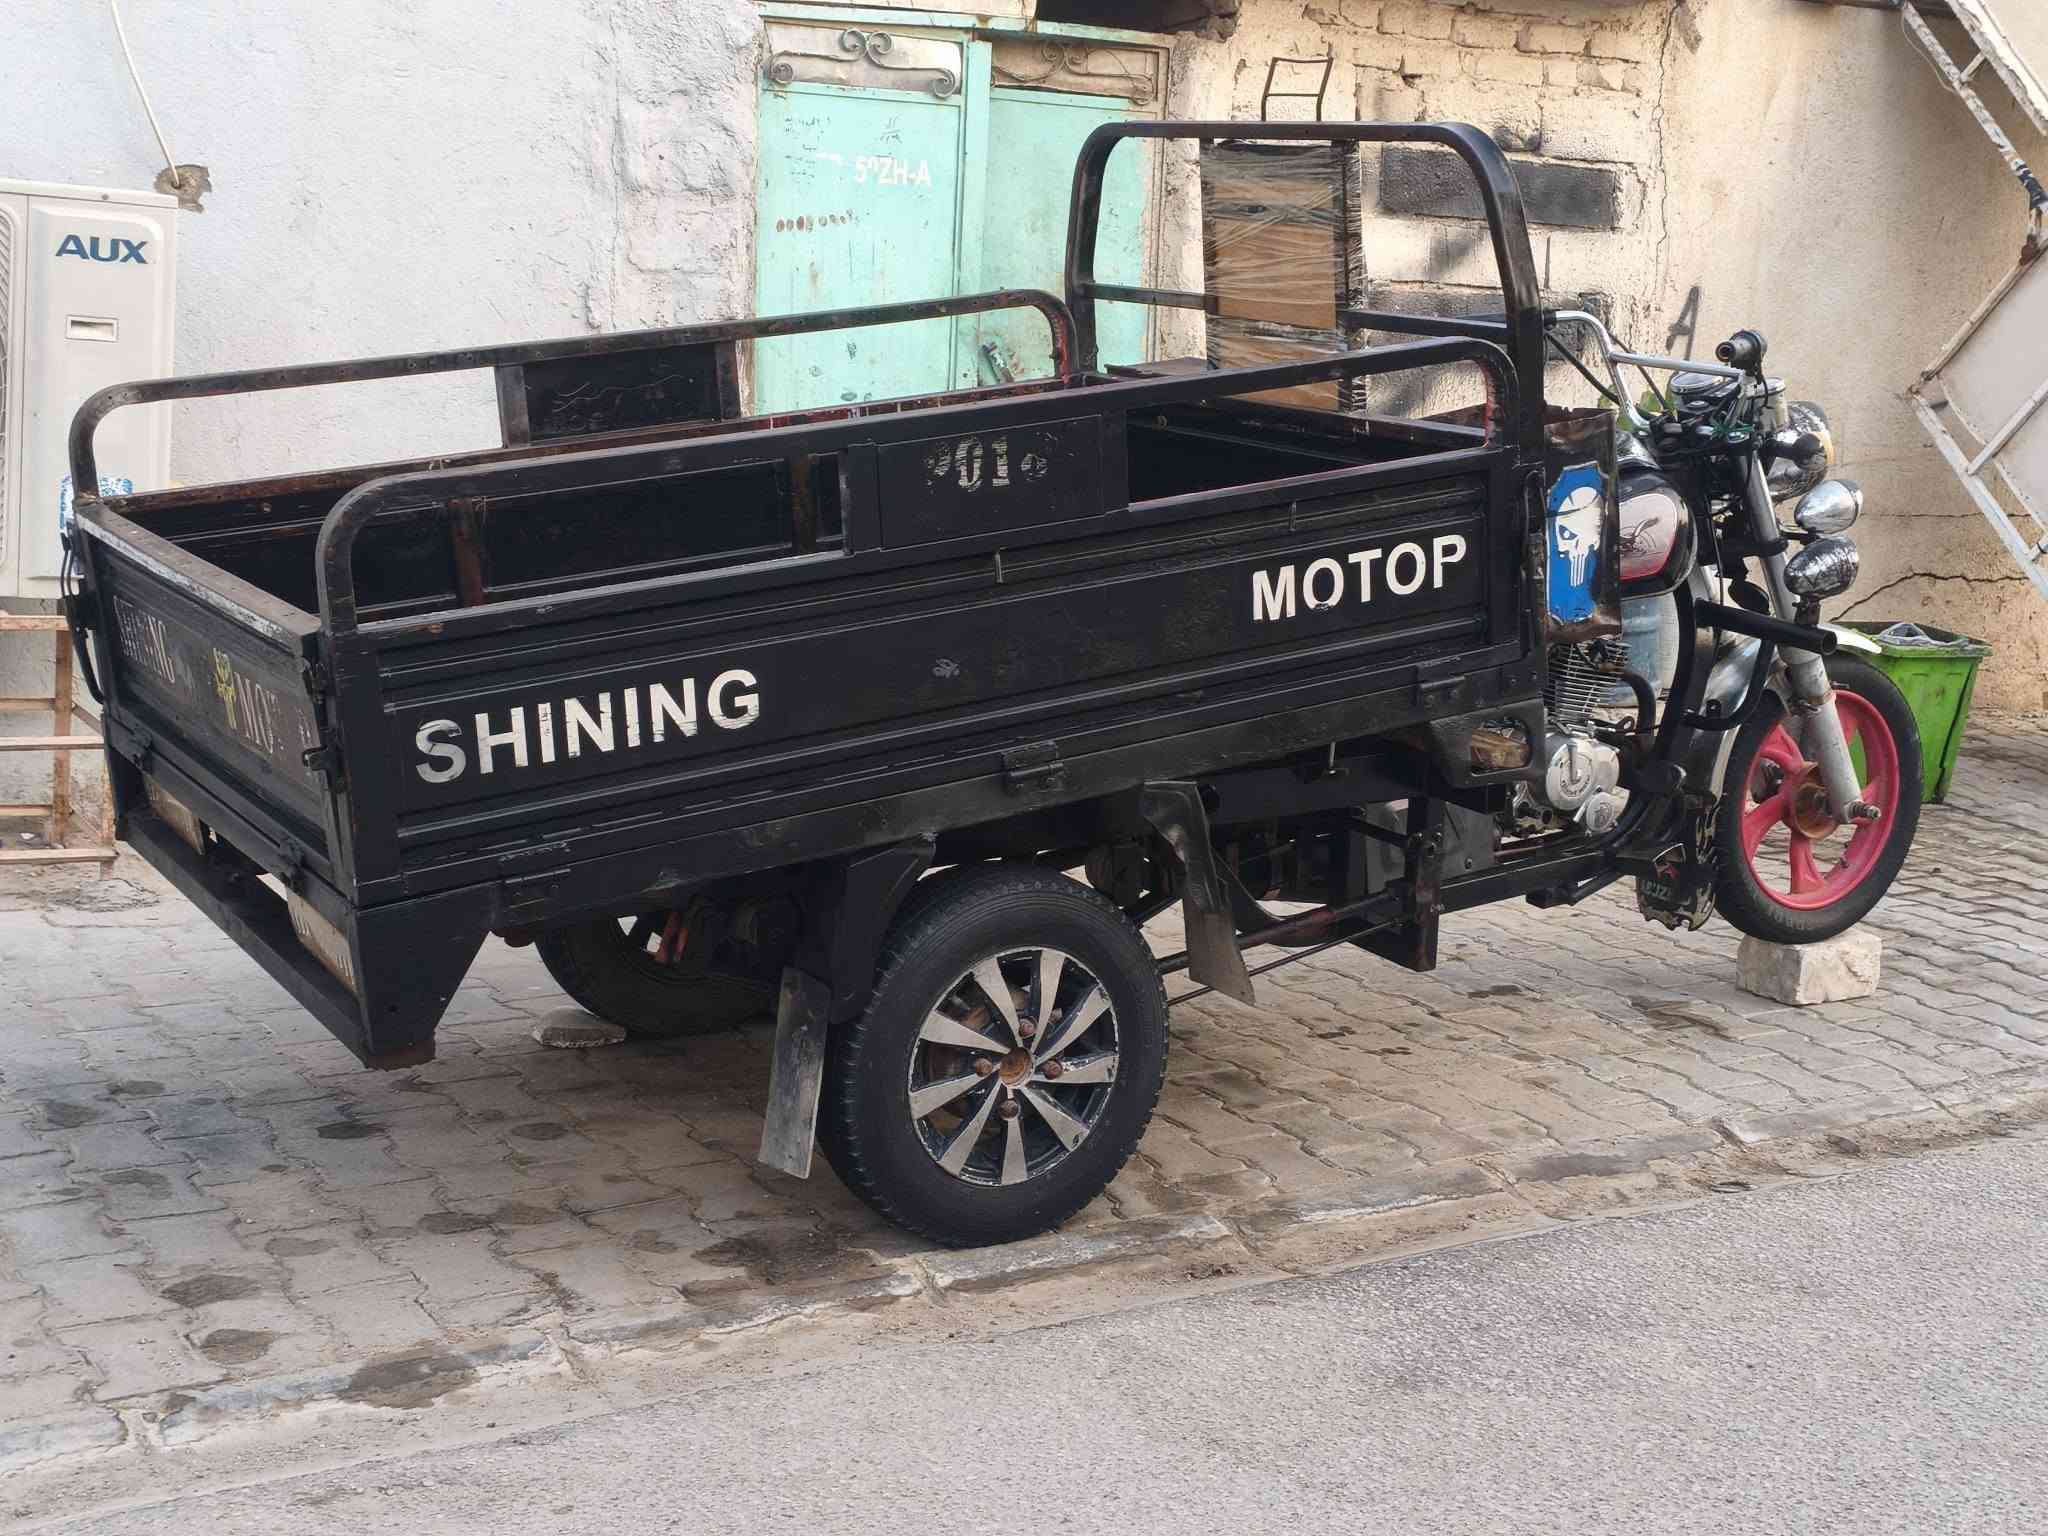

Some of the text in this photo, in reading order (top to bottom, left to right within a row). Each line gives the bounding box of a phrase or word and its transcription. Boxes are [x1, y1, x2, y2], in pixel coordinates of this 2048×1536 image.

[55, 233, 148, 264] AUX
[1252, 534, 1467, 621] MOTOP
[415, 669, 760, 783] SHINING
